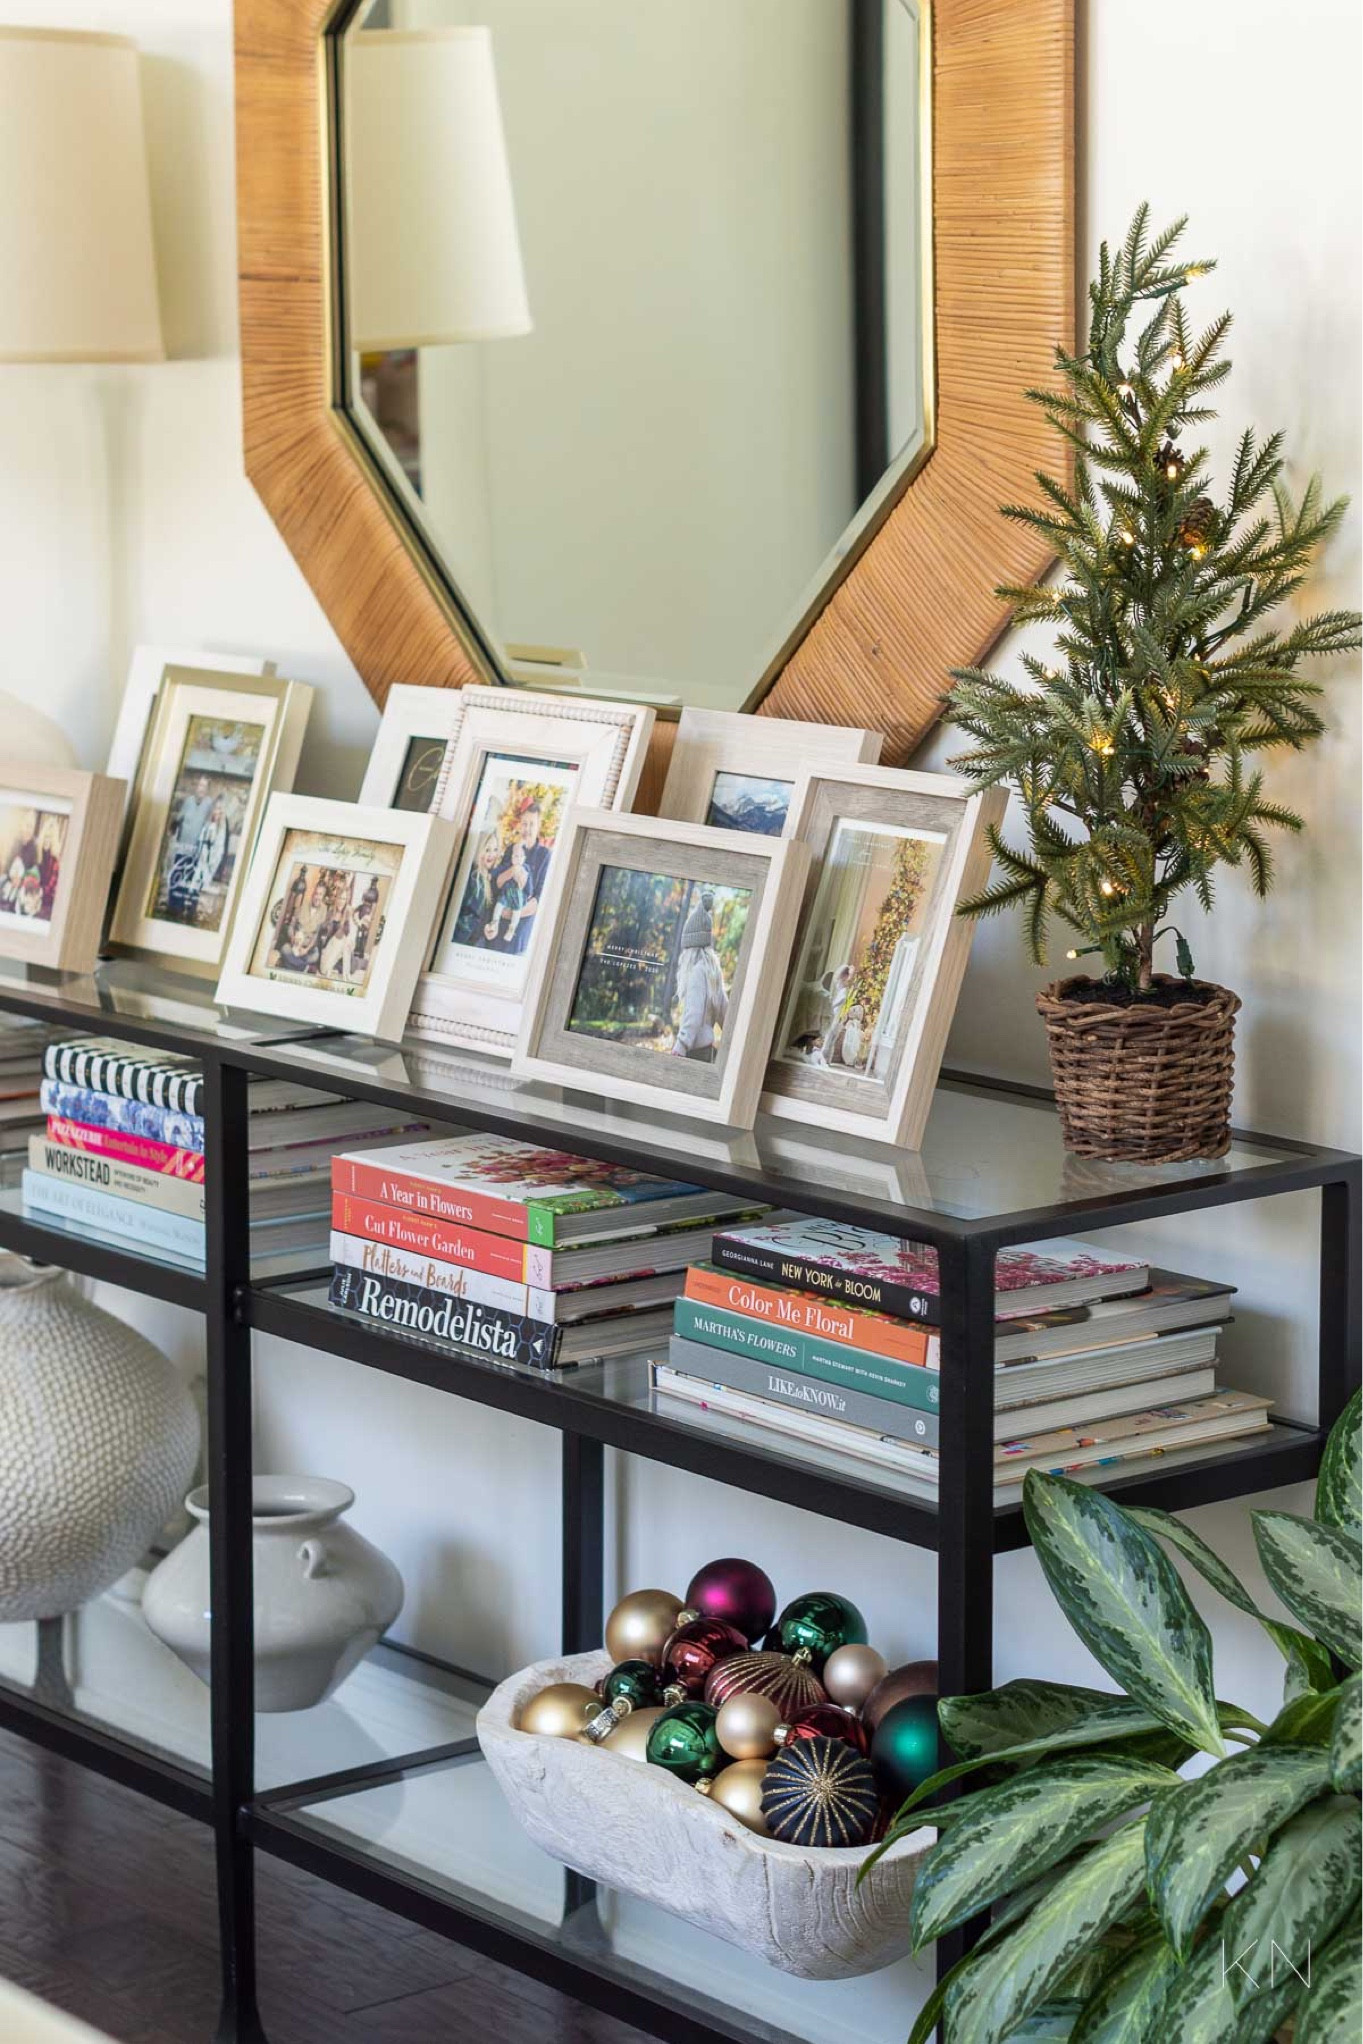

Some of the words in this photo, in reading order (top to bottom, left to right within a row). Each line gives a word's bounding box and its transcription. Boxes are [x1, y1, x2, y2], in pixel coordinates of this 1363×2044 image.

[45, 1146, 110, 1185] WORKSTEAD
[380, 1182, 388, 1199] A
[391, 1183, 414, 1205] Year
[417, 1192, 428, 1209] in
[430, 1194, 473, 1221] Flowers
[365, 1215, 386, 1236] Cut
[388, 1220, 429, 1248] Flower
[432, 1233, 475, 1261] Garden
[362, 1243, 409, 1280] Platters
[426, 1263, 468, 1298] Boards
[760, 1259, 774, 1270] LANE
[781, 1263, 803, 1280] NEW
[805, 1268, 834, 1290] YORK
[844, 1279, 881, 1302] BLOOM
[358, 1276, 517, 1359] Remodelista
[728, 1285, 773, 1315] Color
[775, 1299, 801, 1324] Me
[805, 1306, 854, 1340] Floral
[694, 1316, 746, 1343] MARTHA'S
[747, 1333, 798, 1358] FLOWERS
[832, 1360, 855, 1373] STEWART
